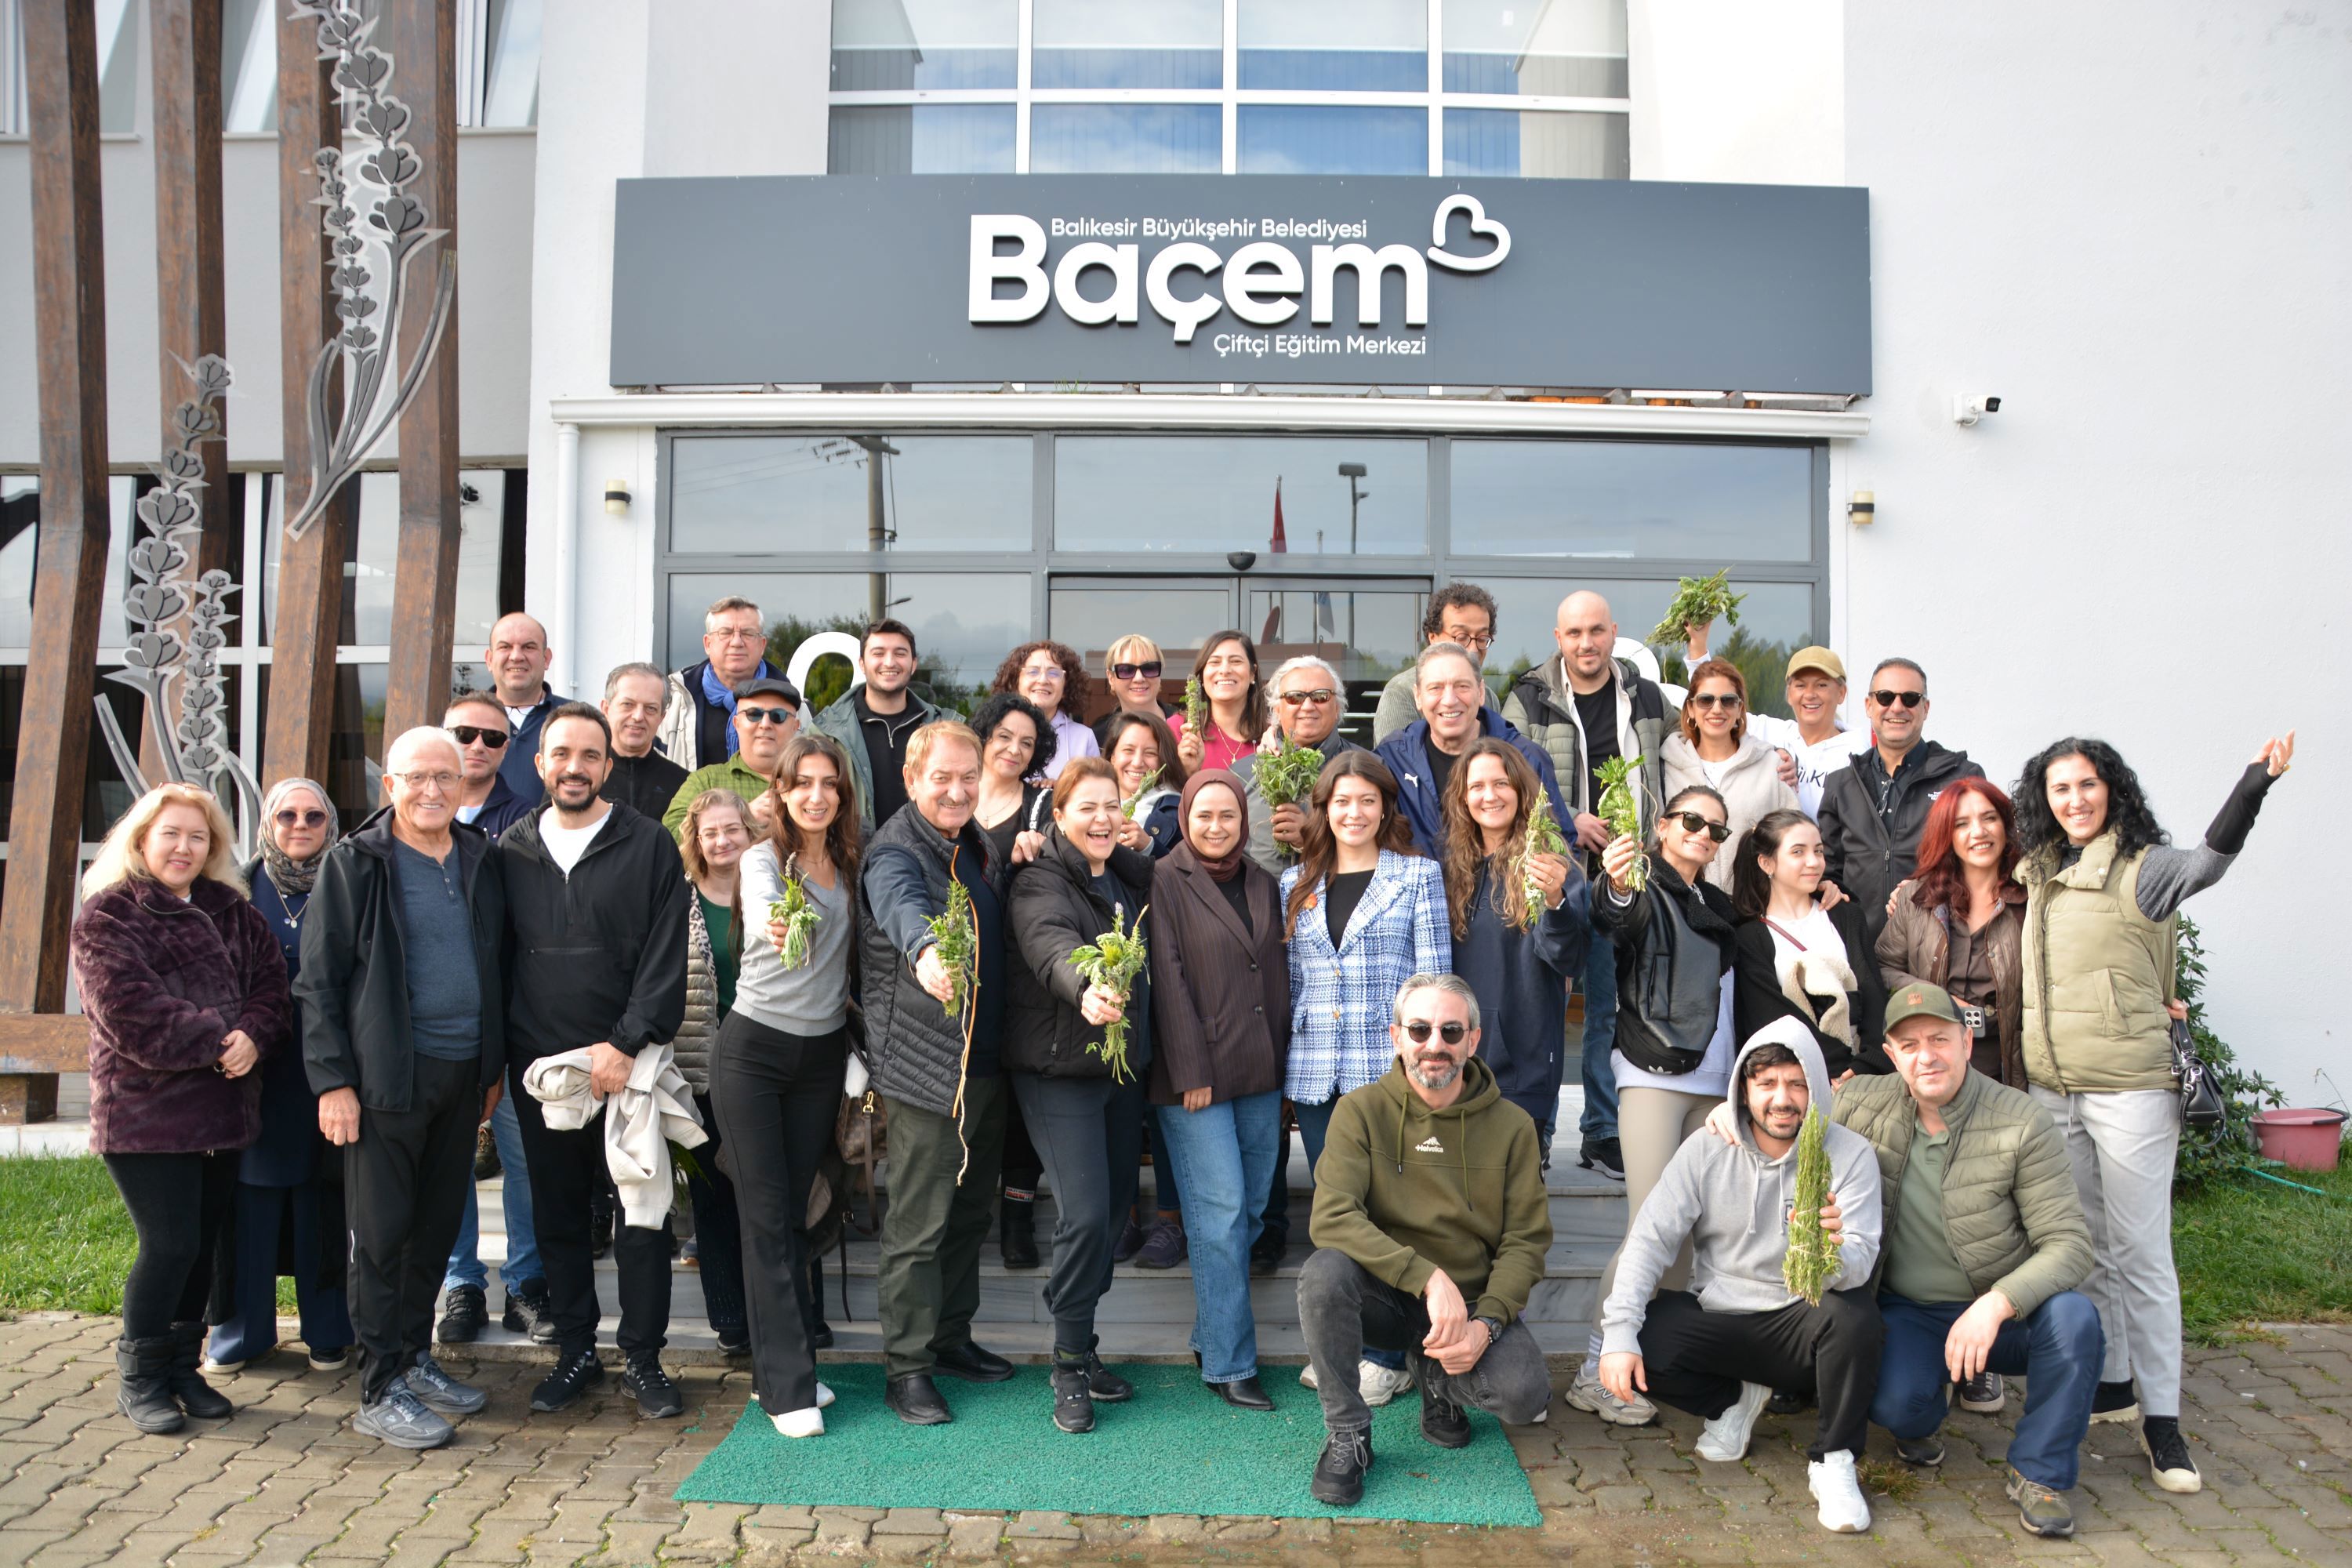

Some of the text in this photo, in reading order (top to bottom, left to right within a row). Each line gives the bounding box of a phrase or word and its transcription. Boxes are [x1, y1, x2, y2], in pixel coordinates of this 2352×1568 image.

[1051, 217, 1367, 242] Balıkesir Büyükşehir Belediyesi
[968, 214, 1428, 343] Baçem
[1214, 333, 1427, 358] Çiftçi Eğitim Merkezi
